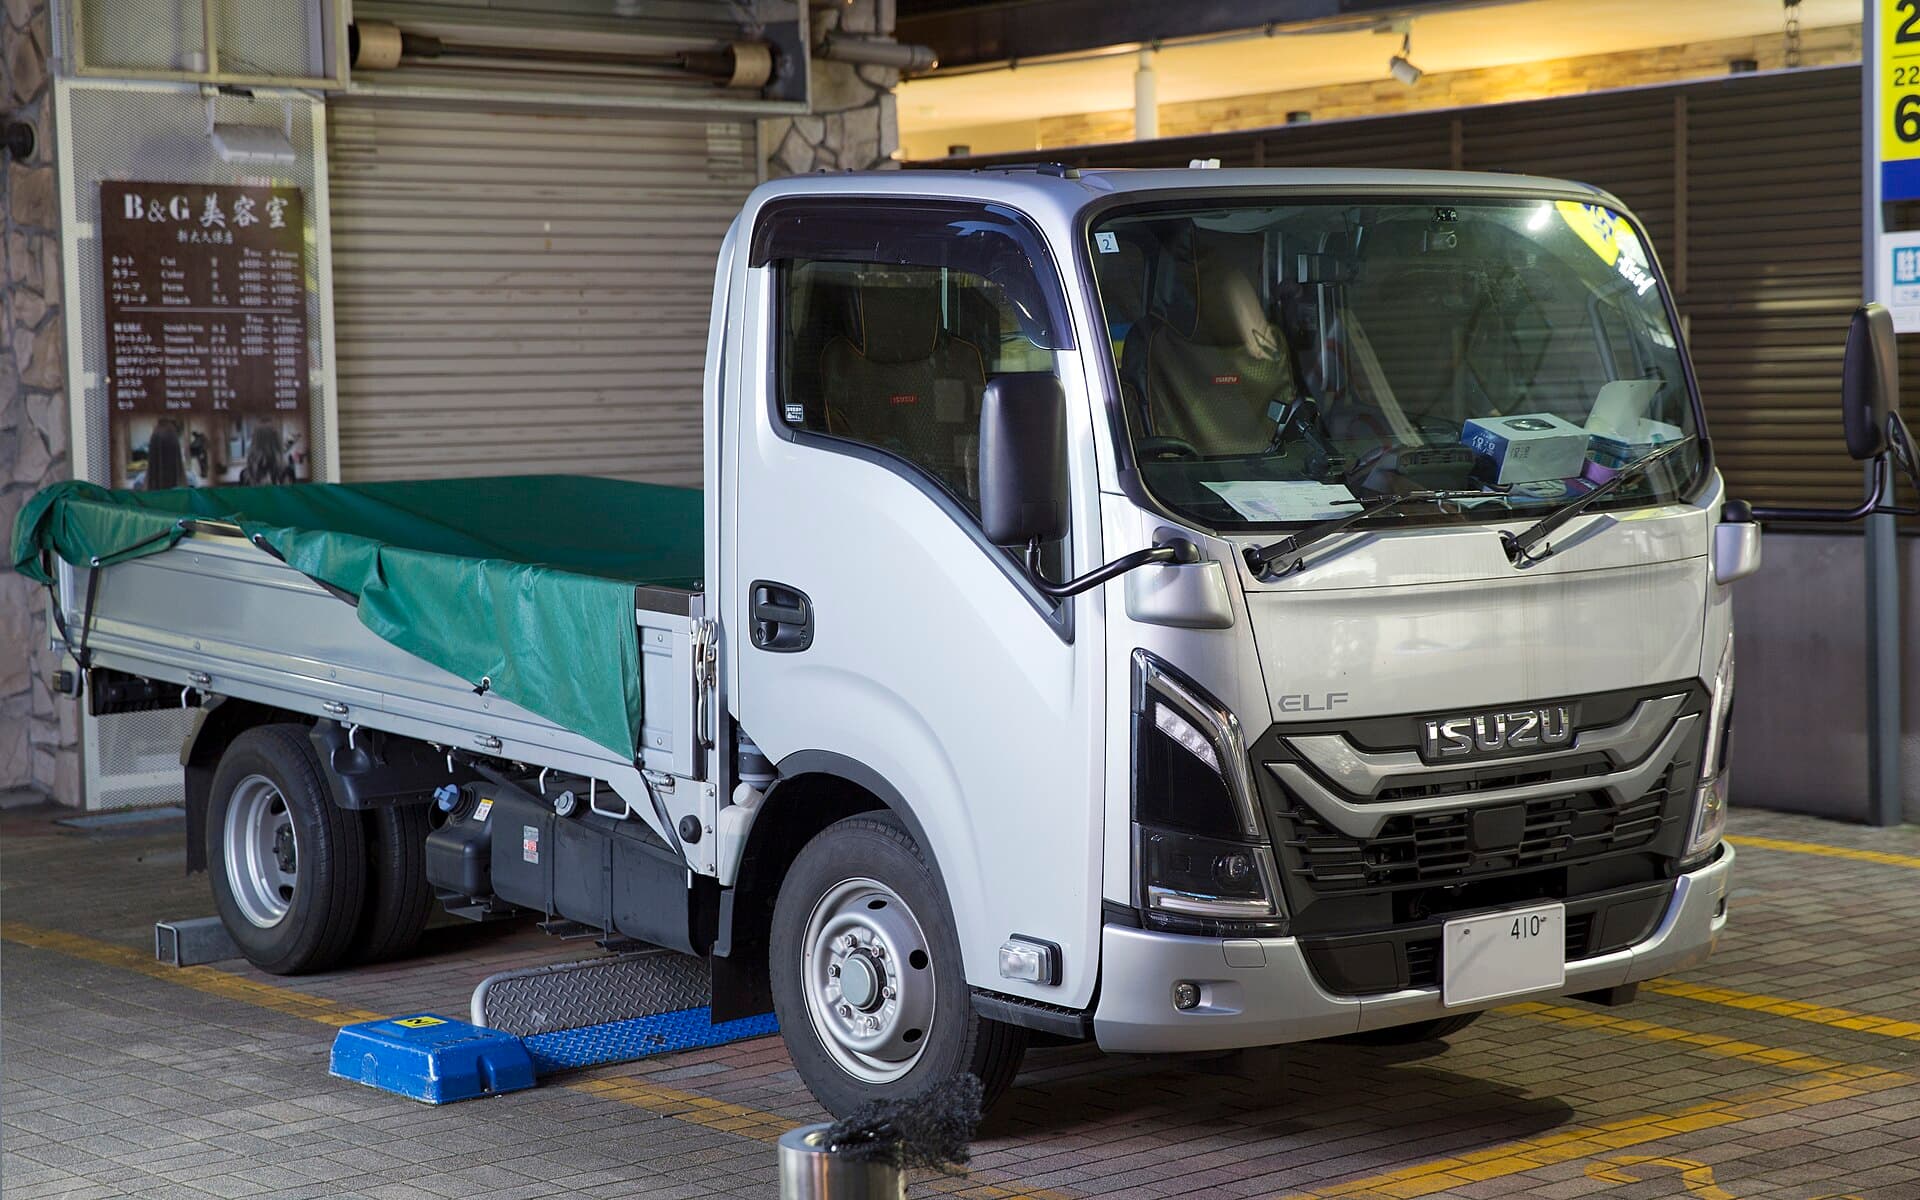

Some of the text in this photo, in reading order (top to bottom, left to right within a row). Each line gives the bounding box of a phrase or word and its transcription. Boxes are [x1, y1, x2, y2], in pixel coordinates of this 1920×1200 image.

[1894, 66, 1919, 87] 22
[1894, 94, 1920, 143] 6
[124, 192, 288, 229] B&G 美容室
[1102, 239, 1112, 250] 2
[1278, 692, 1349, 713] ELF
[1425, 706, 1569, 758] ISUZU
[1511, 915, 1540, 940] 410
